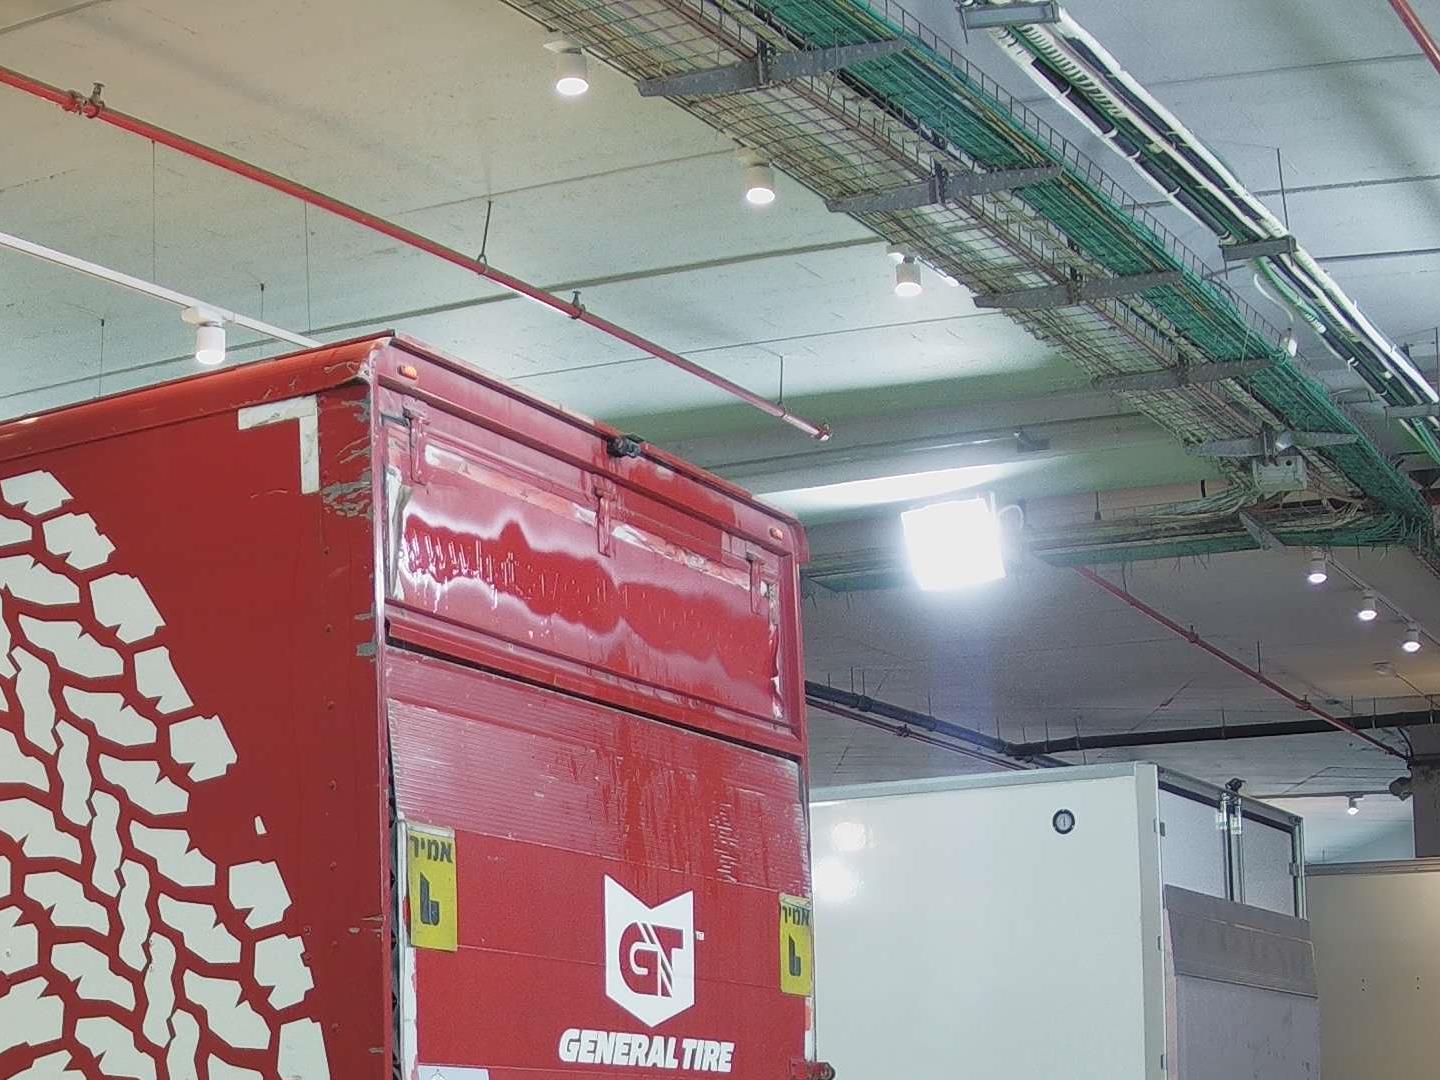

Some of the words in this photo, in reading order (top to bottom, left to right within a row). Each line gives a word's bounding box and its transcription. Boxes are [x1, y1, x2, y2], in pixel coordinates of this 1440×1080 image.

[410, 835, 454, 864] אמיר
[559, 1028, 679, 1069] GENERAL
[682, 1038, 735, 1073] TIRE
